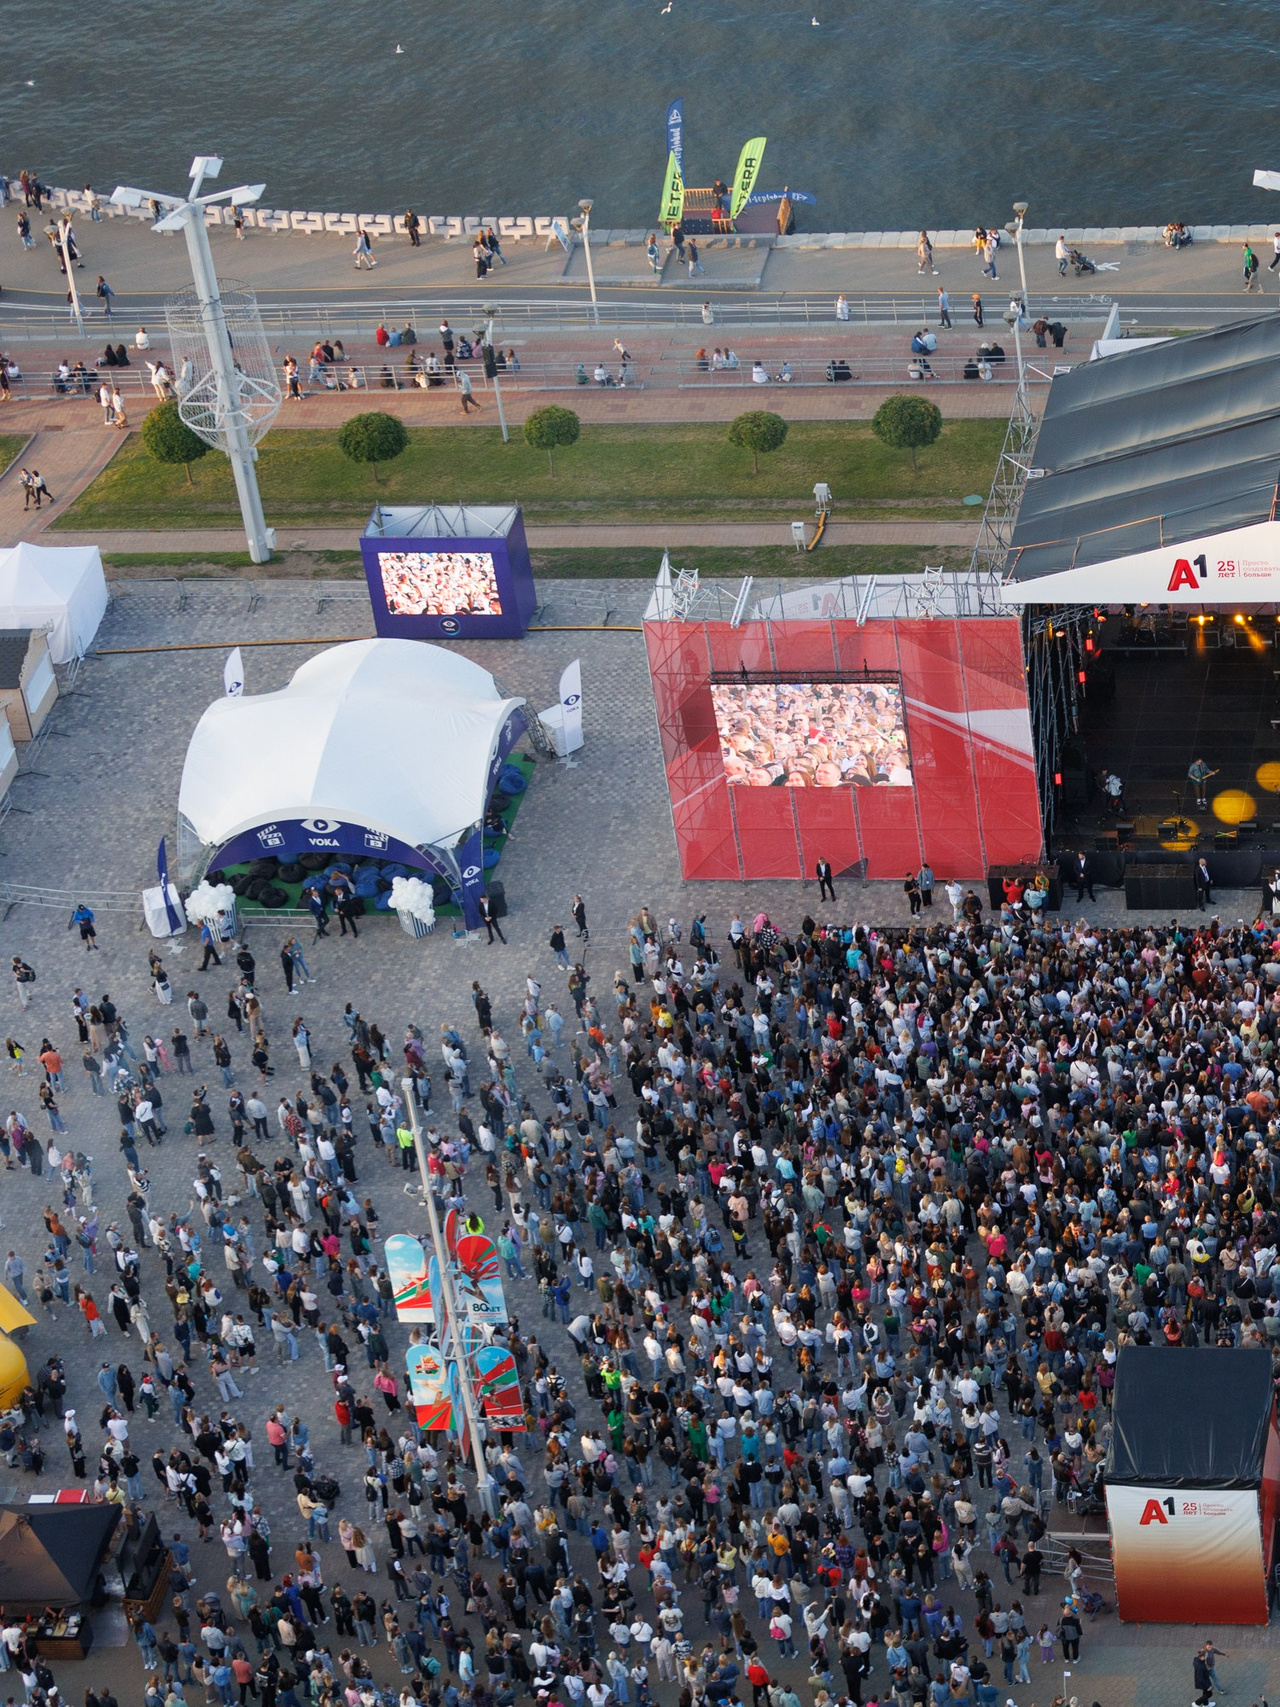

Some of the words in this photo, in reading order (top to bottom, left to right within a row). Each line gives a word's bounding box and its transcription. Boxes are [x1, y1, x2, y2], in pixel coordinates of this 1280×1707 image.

[1217, 561, 1235, 572] 25
[1167, 554, 1208, 591] A1
[308, 837, 340, 847] VOKA
[472, 1303, 489, 1312] 80
[1139, 1496, 1176, 1525] A1
[1182, 1502, 1198, 1511] 25
